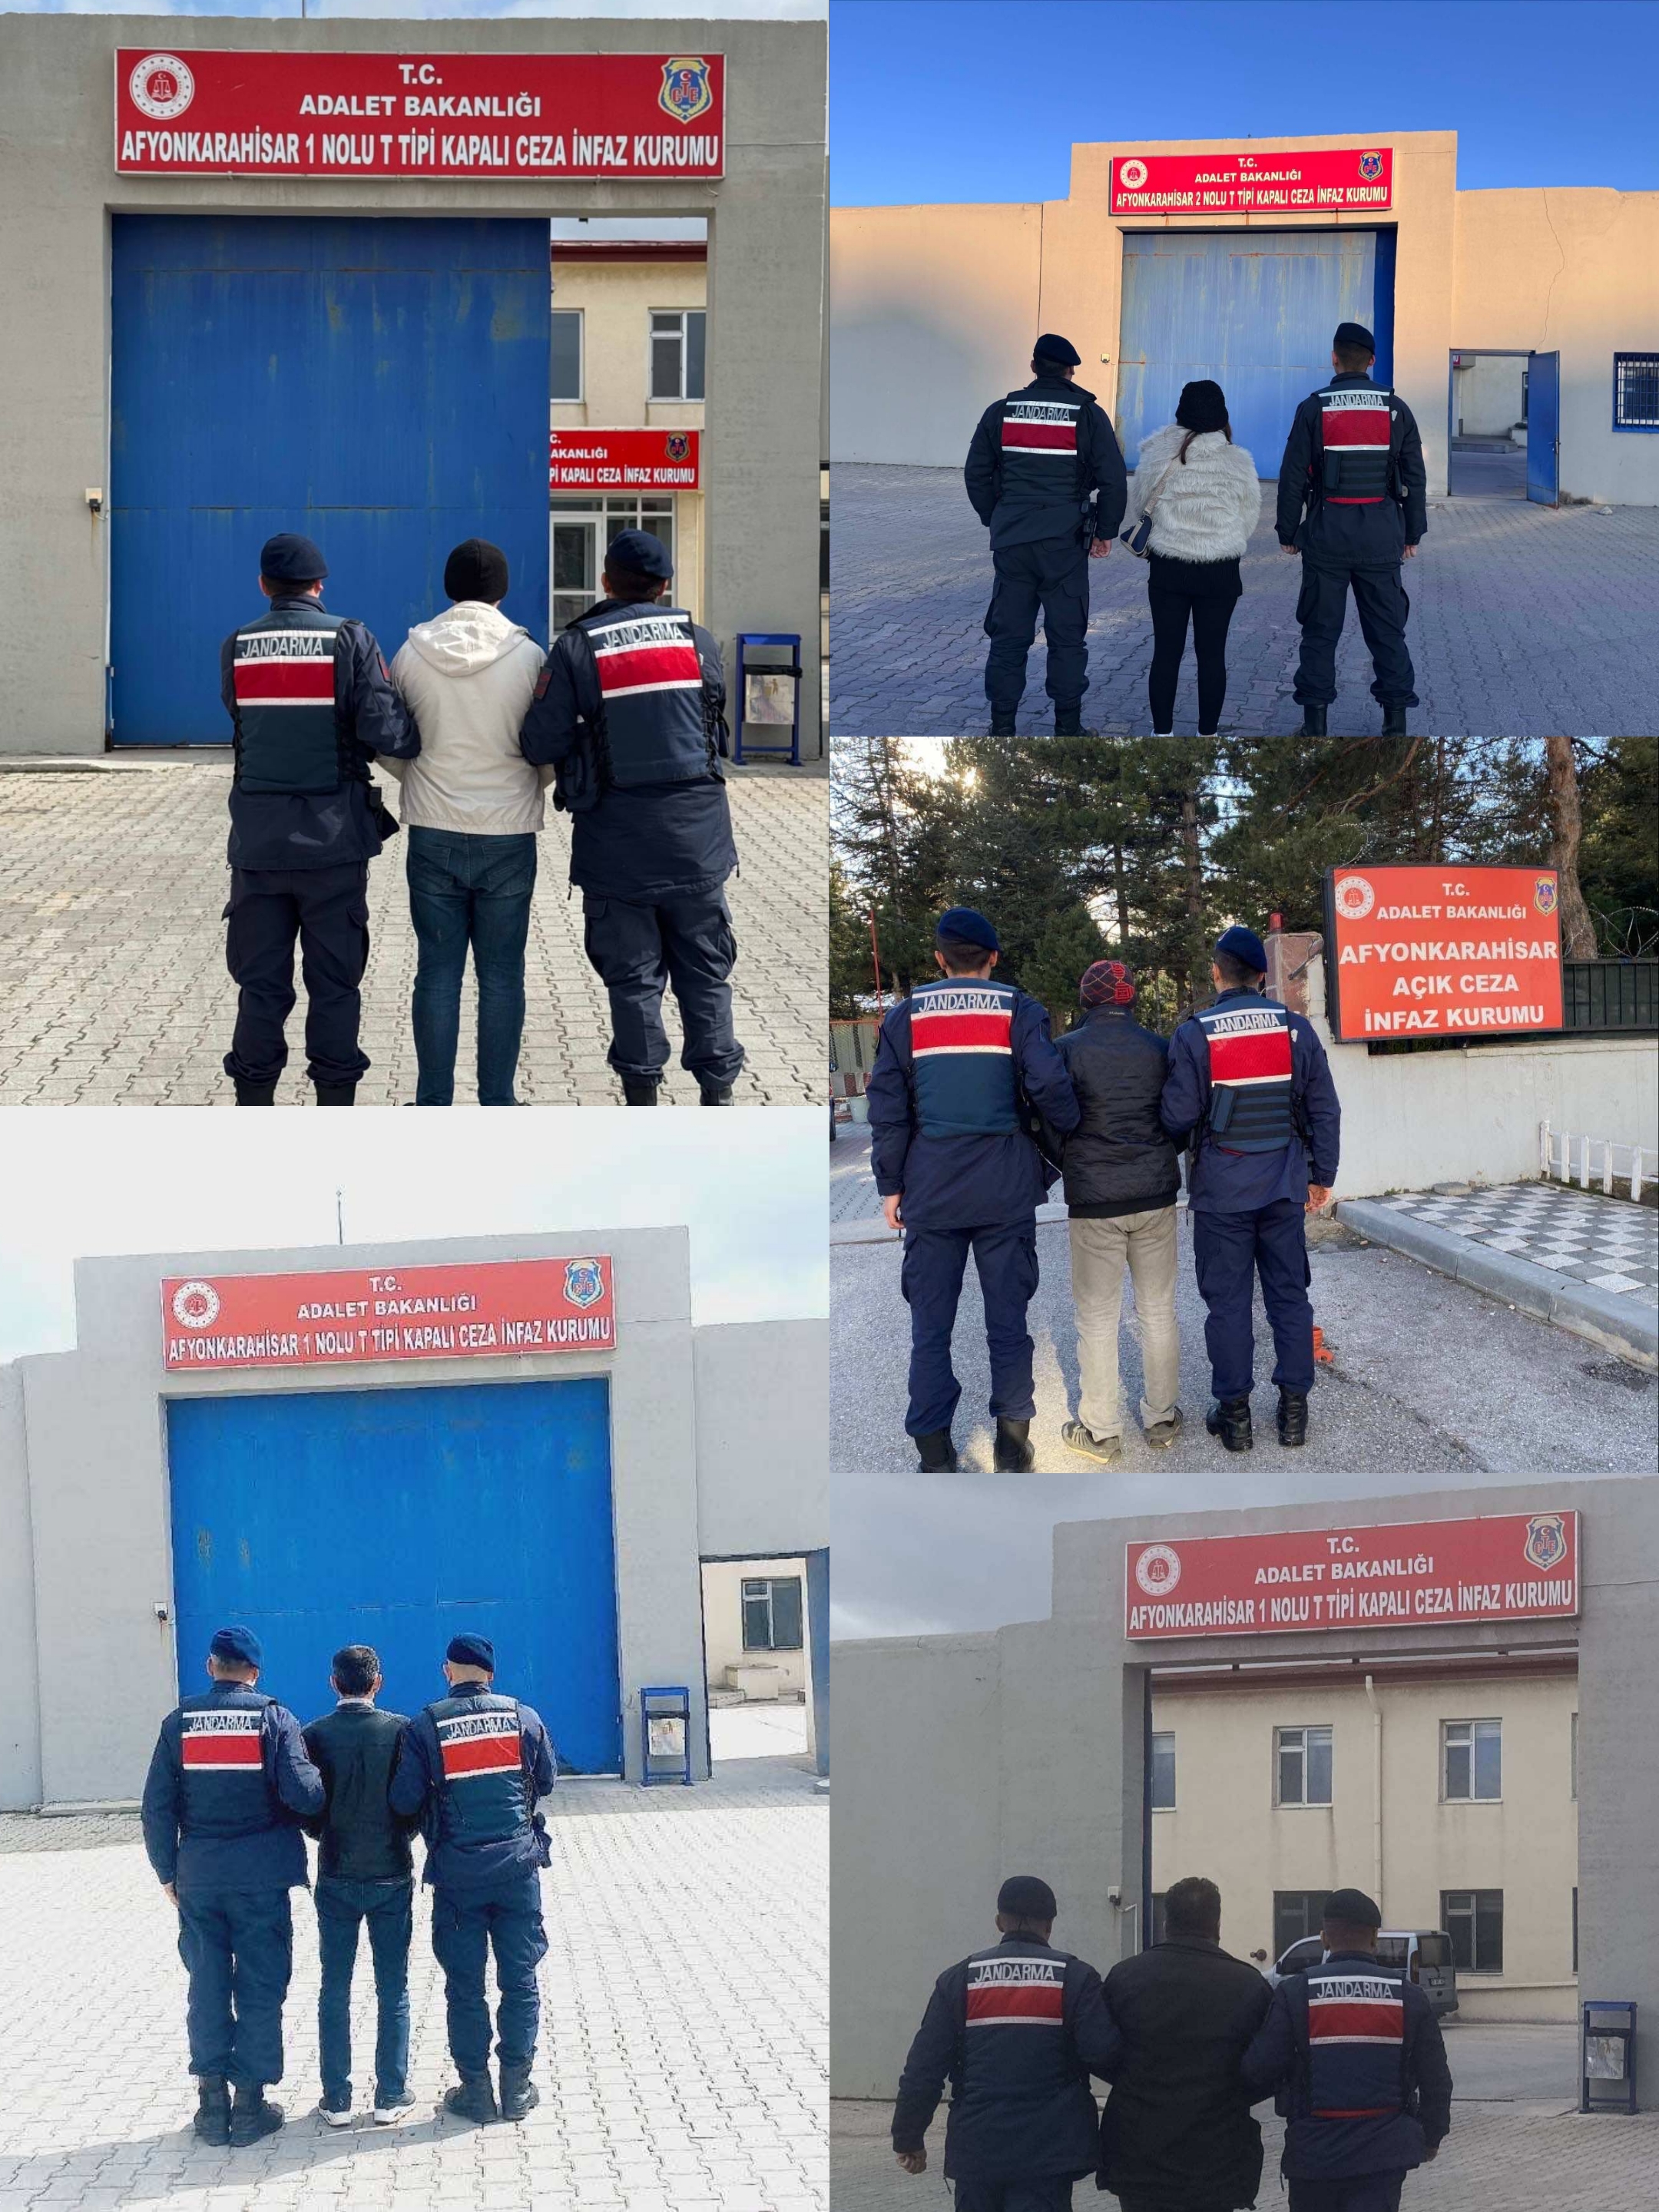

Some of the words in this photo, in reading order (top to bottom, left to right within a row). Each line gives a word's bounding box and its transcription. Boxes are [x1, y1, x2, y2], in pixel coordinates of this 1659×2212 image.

[399, 64, 442, 84] T.C.
[300, 95, 396, 115] ADALET
[405, 92, 540, 117] BAKANLIĞI
[121, 126, 300, 163] AFYONKARAHİSAR
[306, 134, 313, 164] 1
[323, 134, 374, 164] NOLU
[380, 135, 392, 164] T
[398, 127, 435, 164] TİPİ
[442, 135, 509, 165] KAPALI
[516, 135, 566, 166] CEZA
[573, 128, 628, 165] İNFAZ
[634, 136, 718, 166] KURUMU
[1238, 158, 1257, 167] T.C.
[1195, 173, 1237, 183] ADALET
[1240, 169, 1301, 181] BAKANLIĞI
[1117, 189, 1193, 207] AFYONKARAHİSAR
[1196, 191, 1200, 206] 2
[1204, 191, 1227, 205] NOLU
[1230, 191, 1234, 205] T
[1237, 187, 1253, 204] TİPİ
[1257, 190, 1288, 204] KAPALI
[1291, 189, 1314, 204] CEZA
[1317, 185, 1343, 203] İNFAZ
[1346, 187, 1387, 202] KURUMU
[1329, 393, 1383, 406] JANDARMA
[1012, 404, 1070, 422] JANDARMA
[549, 434, 561, 443] C.
[551, 447, 608, 459] AKANLIĞI
[549, 465, 558, 482] Pİ
[561, 468, 594, 482] KAPALI
[597, 468, 621, 482] CEZA
[624, 465, 651, 482] İNFAZ
[654, 468, 694, 482] KURUMU
[602, 623, 685, 648] JANDARMA
[241, 637, 323, 657] JANDARMA
[1442, 883, 1469, 896] T.C.
[1377, 906, 1441, 919] ADALET
[1447, 904, 1526, 919] BAKANLIĞI
[1339, 938, 1558, 965] AFYONKARAHİSAR
[1393, 975, 1453, 999] AÇIK
[1460, 975, 1519, 993] CEZA
[919, 993, 1001, 1012] JANDARMA
[1213, 1012, 1280, 1033] JANDARMA
[1365, 1008, 1439, 1031] İNFAZ
[1447, 1005, 1543, 1026] KURUMU
[369, 1276, 401, 1292] T.C.
[298, 1301, 368, 1318] ADALET
[376, 1293, 475, 1315] BAKANLIĞI
[169, 1329, 299, 1362] AFYONKARAHİSAR
[303, 1333, 310, 1355] 1
[316, 1332, 353, 1354] NOLU
[359, 1331, 367, 1352] T
[372, 1323, 399, 1351] TİPİ
[404, 1326, 456, 1350] KAPALI
[459, 1323, 497, 1347] CEZA
[502, 1318, 542, 1344] İNFAZ
[548, 1317, 610, 1342] KURUMU
[1327, 1537, 1359, 1554] T.C.
[1255, 1565, 1326, 1584] ADALET
[1331, 1553, 1433, 1579] BAKANLIĞI
[1130, 1595, 1255, 1630] AFYONKARAHİSAR
[1259, 1601, 1266, 1623] 1
[1271, 1597, 1309, 1621] NOLU
[1313, 1595, 1323, 1619] T
[1326, 1588, 1353, 1618] TİPİ
[1359, 1590, 1409, 1617] KAPALI
[1415, 1588, 1453, 1614] CEZA
[1459, 1581, 1500, 1611] İNFAZ
[1506, 1580, 1571, 1608] KURUMU
[188, 1714, 252, 1732] JANDARMA
[446, 1718, 510, 1739] JANDARMA
[975, 1963, 1055, 1982] JANDARMA
[1316, 1982, 1393, 1999] JANDARMA
